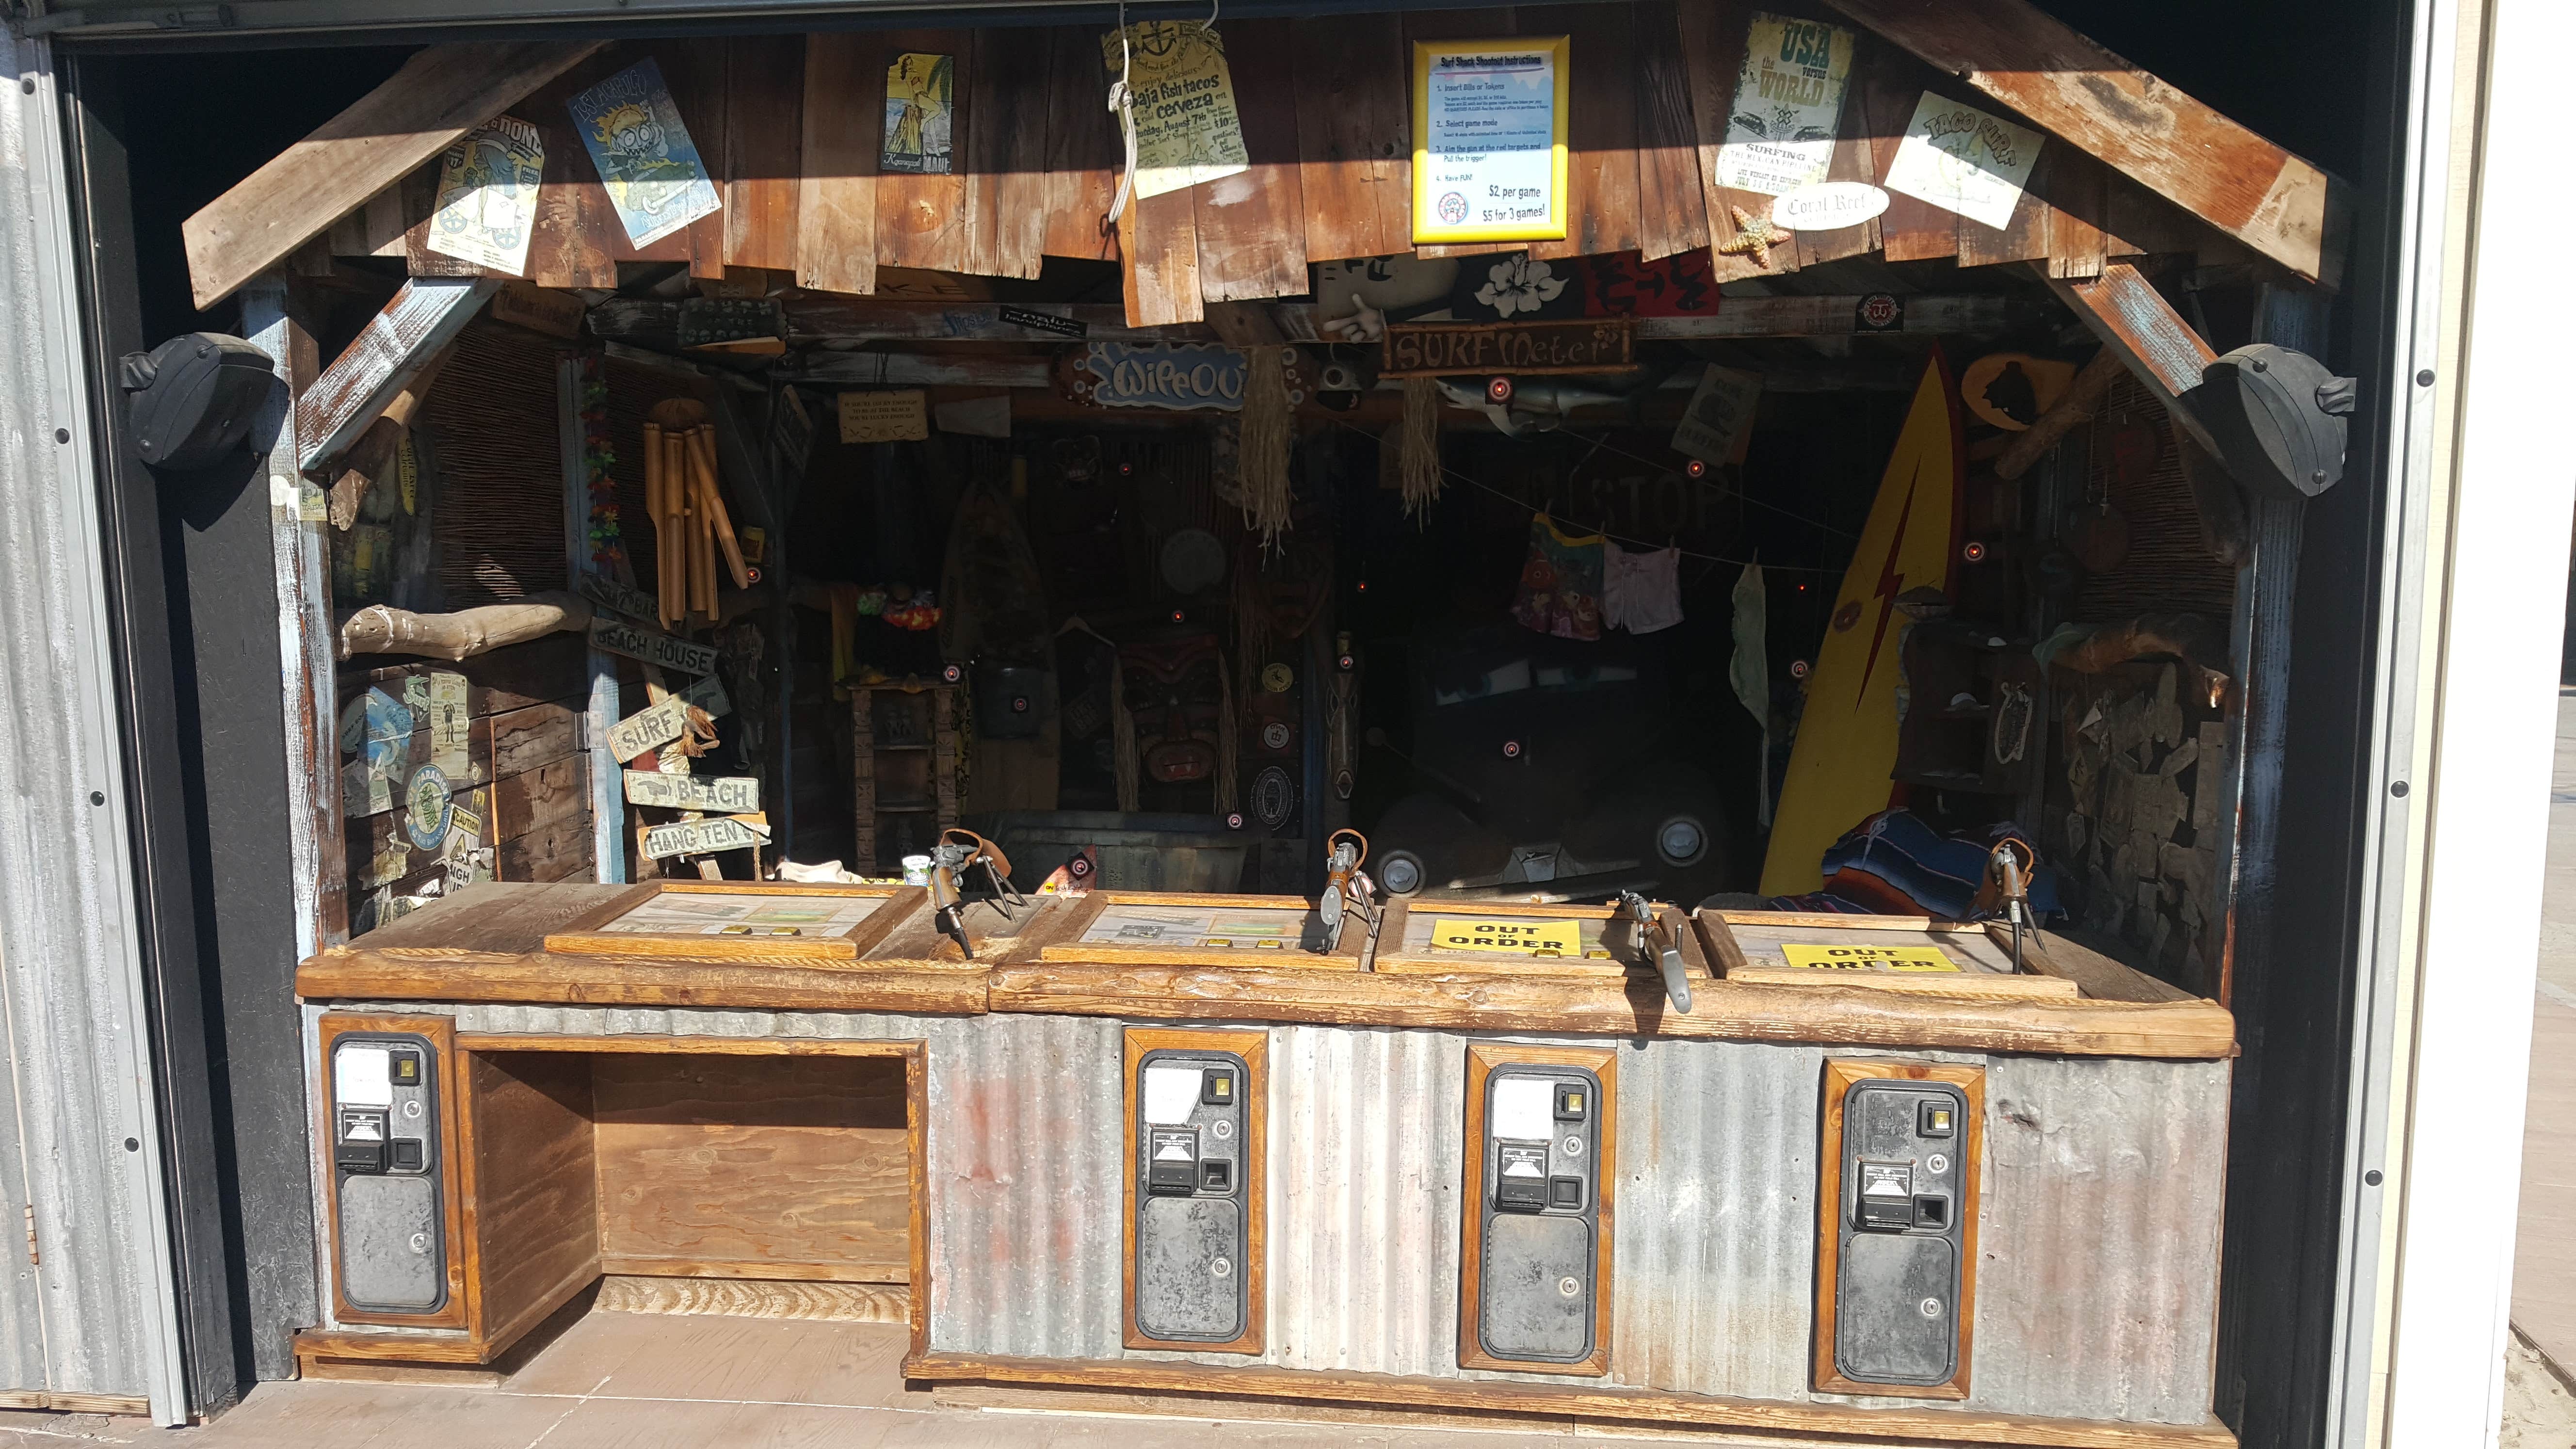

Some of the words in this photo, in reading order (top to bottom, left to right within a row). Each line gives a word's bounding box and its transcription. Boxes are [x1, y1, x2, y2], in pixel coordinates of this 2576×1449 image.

[1780, 23, 1832, 69] USA
[1441, 57, 1454, 67] Surf
[1456, 56, 1475, 67] Shack
[1476, 55, 1503, 66] Shootout
[1505, 54, 1541, 65] Instructions
[1762, 55, 1775, 70] the
[1803, 66, 1827, 79] versus
[1160, 82, 1182, 100] fish
[1183, 74, 1220, 95] tacos
[1485, 82, 1505, 91] Tokens
[1759, 69, 1824, 107] WORLD
[573, 87, 597, 123] LOST
[1156, 92, 1213, 120] cerveza
[1164, 116, 1191, 135] August
[1191, 111, 1207, 126] 7th
[1508, 144, 1529, 152] targets
[1923, 112, 1976, 140] TACO
[1979, 118, 2017, 167] SURF
[1465, 154, 1487, 163] trigger!
[1746, 143, 1806, 161] SURFING
[1460, 174, 1473, 182] FUN!
[1489, 184, 1500, 197] $2
[1502, 188, 1516, 200] per
[1518, 188, 1541, 200] game
[1483, 209, 1493, 222] $5
[1495, 209, 1507, 221] for
[1509, 207, 1514, 220] 3
[1516, 203, 1546, 221] games!
[1787, 196, 1828, 215] Coral
[1396, 331, 1496, 369] SURF
[598, 630, 648, 656] BEACH
[403, 688, 430, 711] Surf
[622, 708, 672, 752] SURF
[418, 770, 449, 796] PARADISE
[676, 779, 748, 806] BEACH
[454, 811, 479, 833] CAUTION
[648, 828, 697, 853] HANG
[700, 821, 738, 845] TEN
[1475, 924, 1541, 935] OUT
[1448, 936, 1564, 950] ORDER
[1827, 949, 1898, 957] OUT
